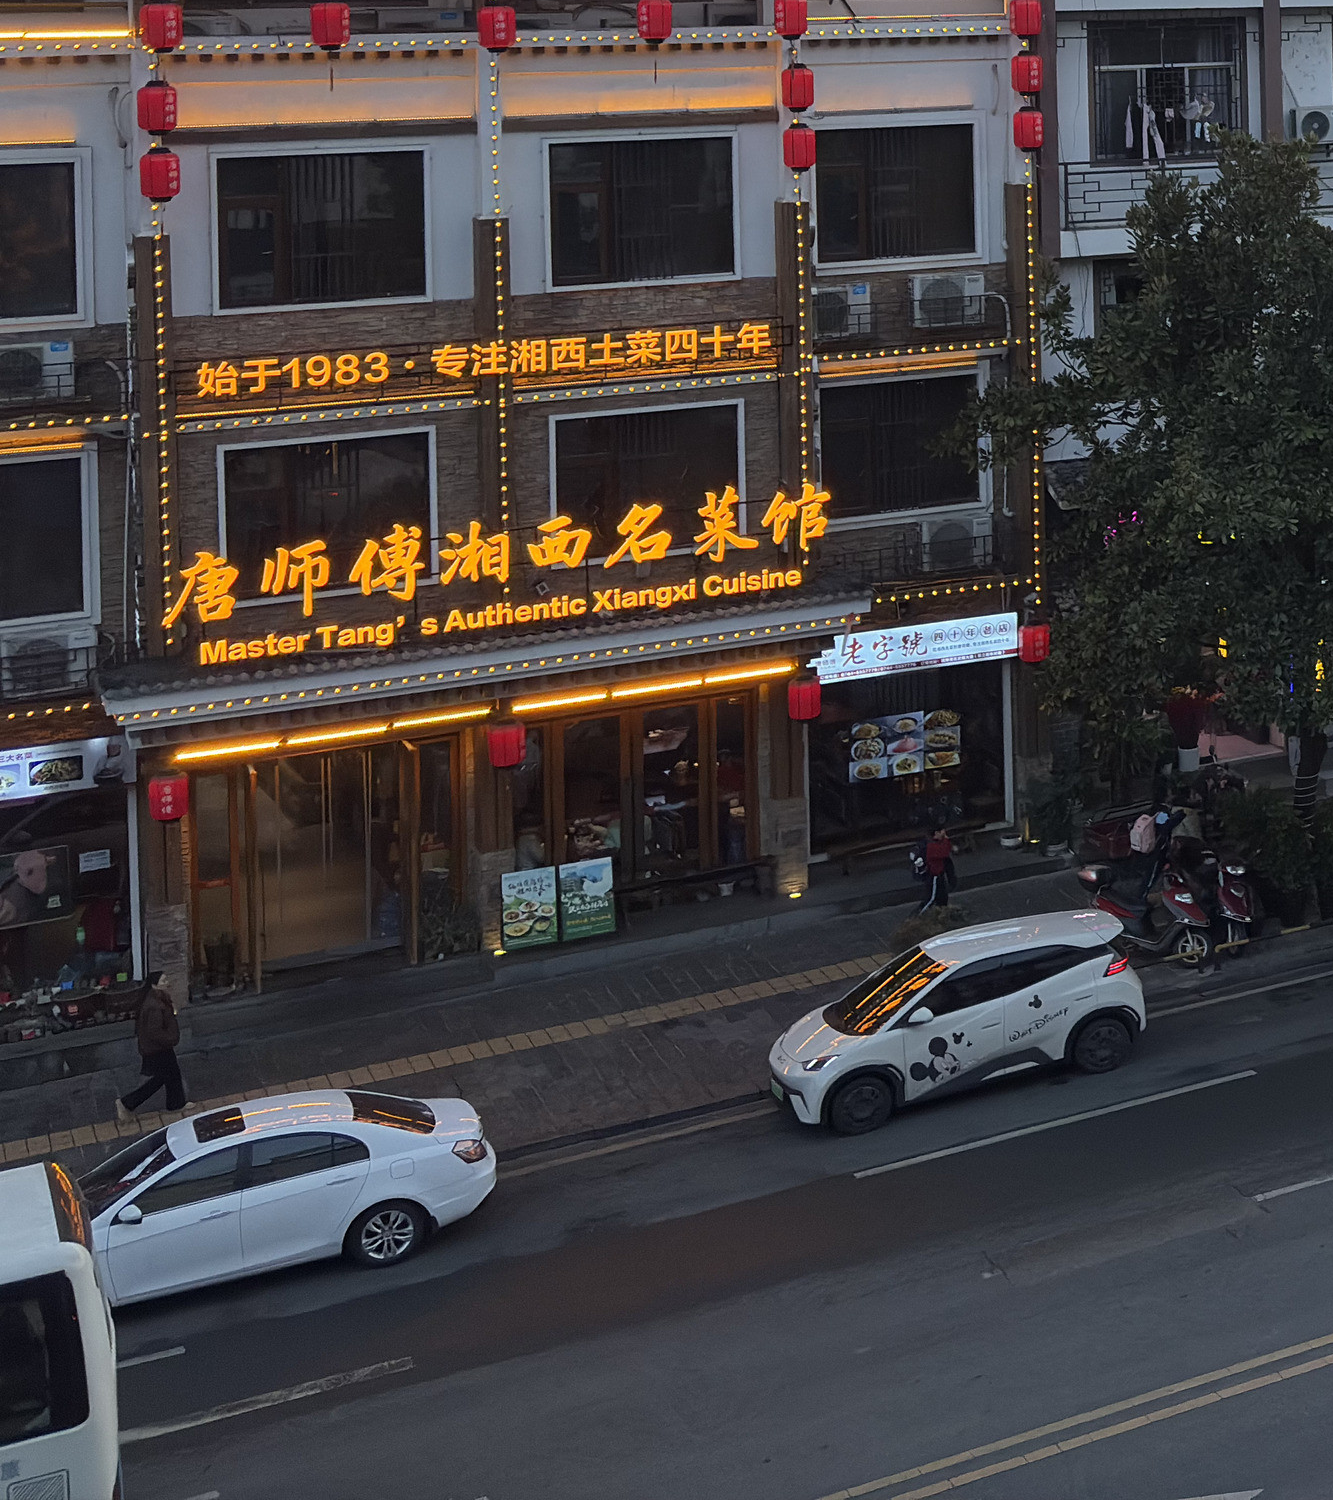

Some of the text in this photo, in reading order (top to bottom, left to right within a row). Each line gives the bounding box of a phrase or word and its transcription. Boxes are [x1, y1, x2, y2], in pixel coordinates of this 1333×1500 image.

[162, 482, 831, 627] 唐师傅湘西名菜馆
[200, 631, 311, 665] Master
[444, 594, 587, 632] Authentic
[592, 577, 696, 613] Xiangxi
[703, 568, 802, 596] Cuisine
[842, 631, 928, 667] 老字號
[933, 620, 1009, 642] 四十年老店
